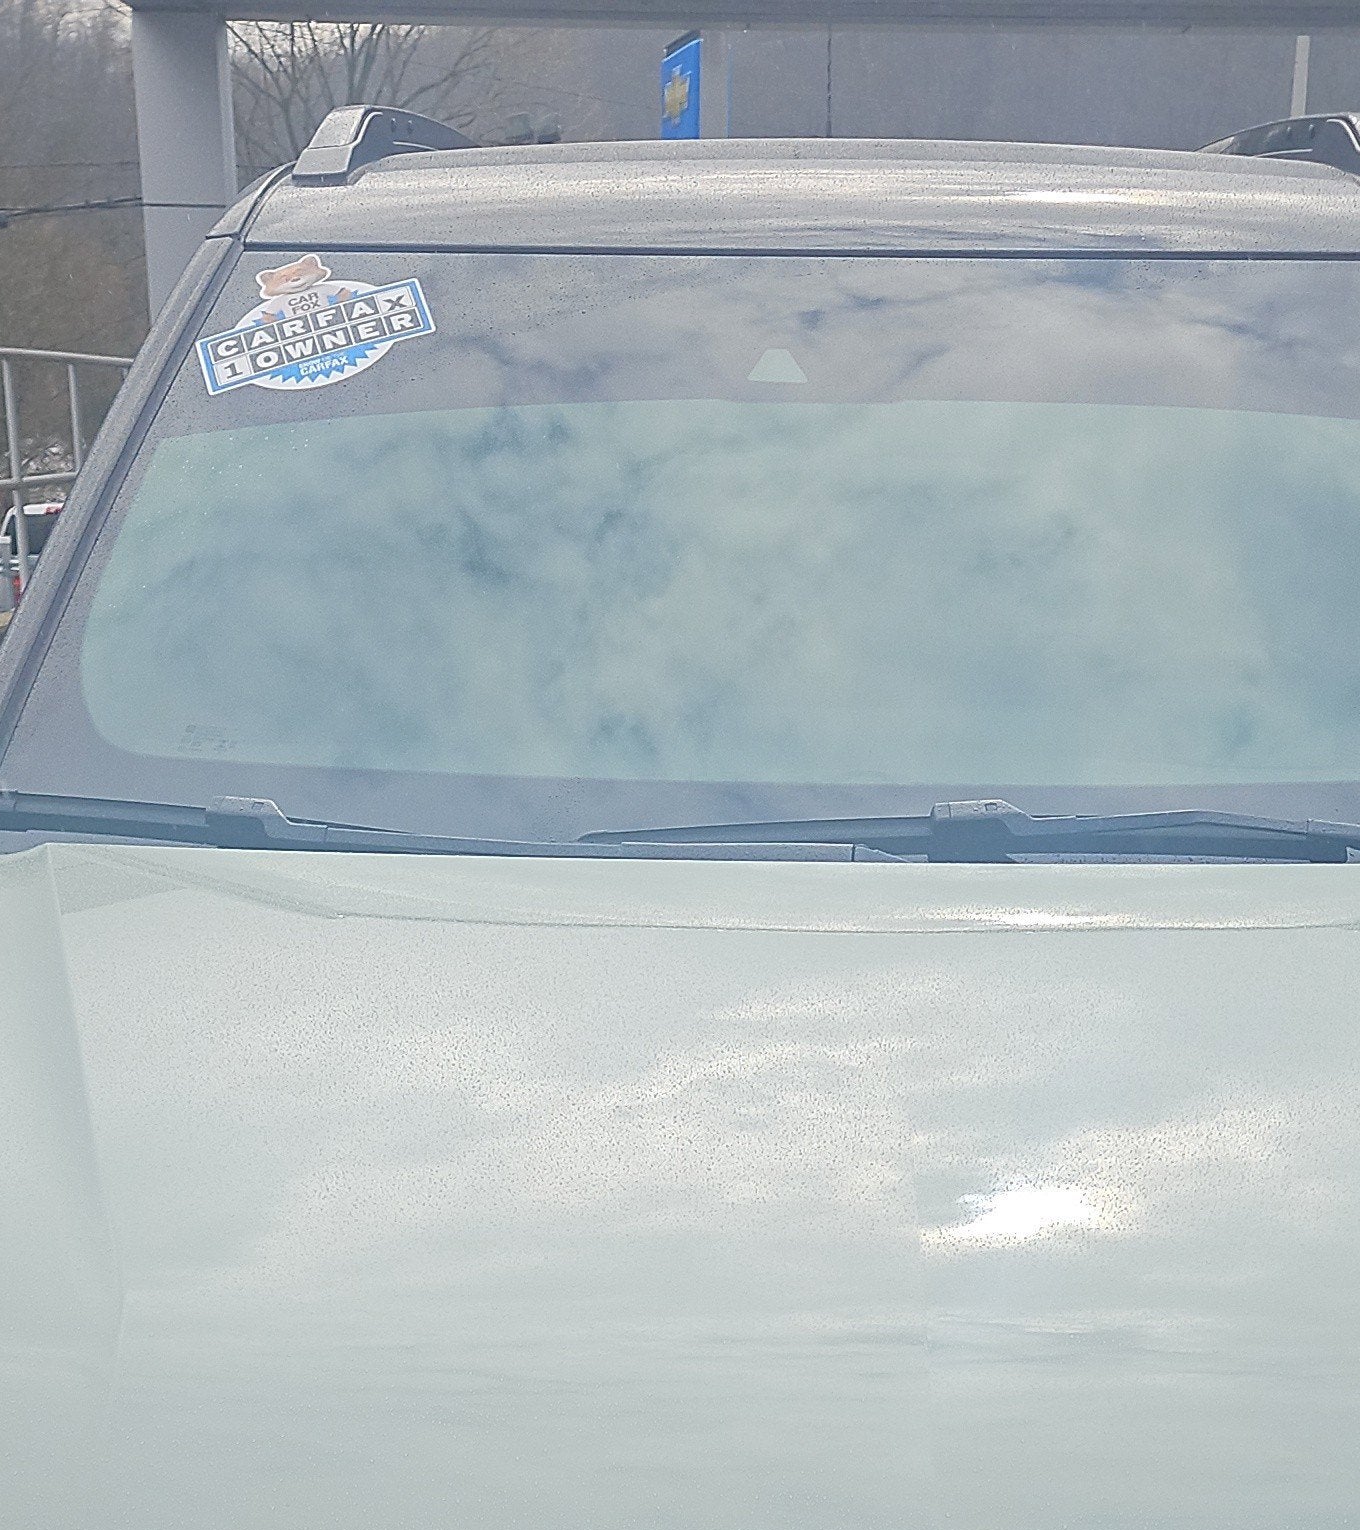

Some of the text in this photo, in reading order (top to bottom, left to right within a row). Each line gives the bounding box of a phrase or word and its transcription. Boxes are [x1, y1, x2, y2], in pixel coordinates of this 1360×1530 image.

[287, 291, 320, 306] CAR
[291, 299, 321, 315] FOX
[216, 294, 412, 360] CARFAX
[299, 355, 349, 376] CARFAX
